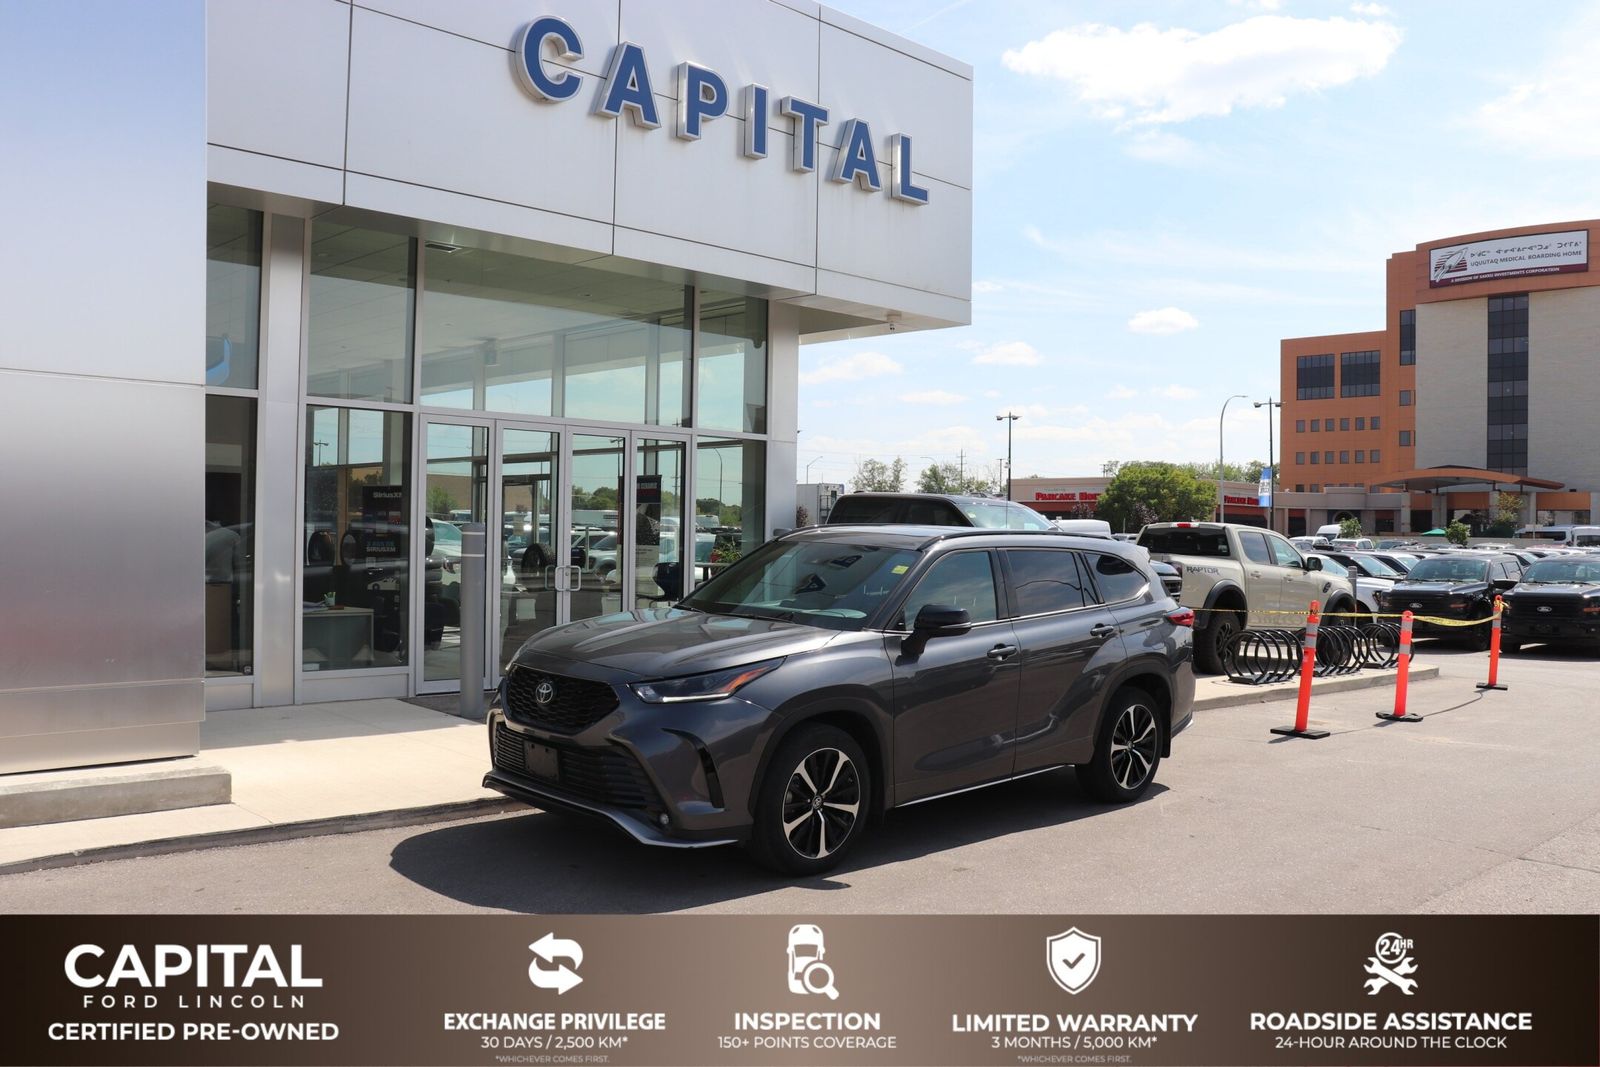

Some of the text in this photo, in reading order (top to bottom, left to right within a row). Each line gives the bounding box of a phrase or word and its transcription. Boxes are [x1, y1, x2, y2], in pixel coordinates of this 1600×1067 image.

[516, 15, 929, 205] CAPITAL
[1470, 257, 1499, 267] UQUUTAQ
[1500, 254, 1526, 263] MEDICAL
[1528, 251, 1561, 260] BOARDING
[1035, 492, 1077, 501] PANCAKE
[1186, 566, 1220, 575] RAPTOR
